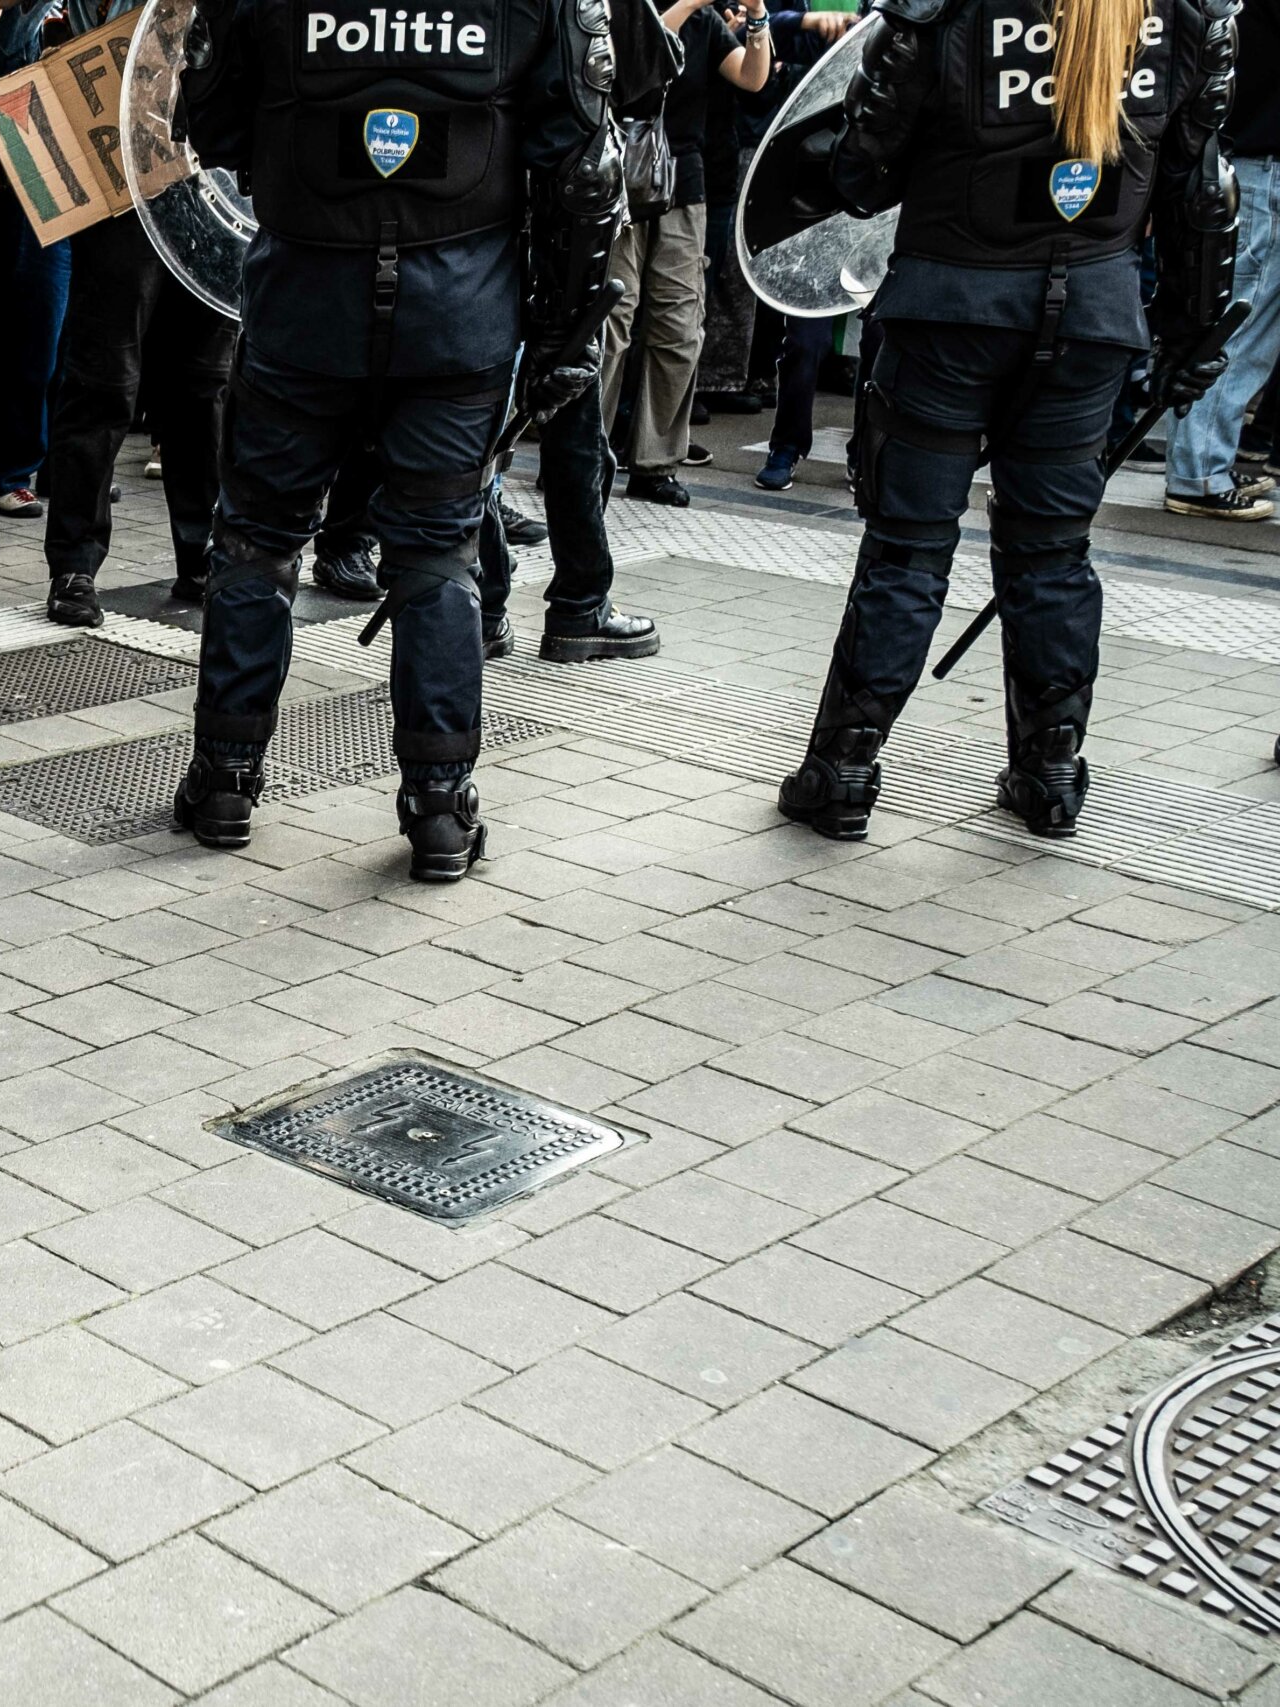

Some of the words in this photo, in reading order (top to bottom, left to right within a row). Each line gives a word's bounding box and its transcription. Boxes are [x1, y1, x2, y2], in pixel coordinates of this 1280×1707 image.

[308, 8, 486, 56] Politie
[405, 1087, 548, 1140] HERMELOCK
[387, 1159, 448, 1184] B125
